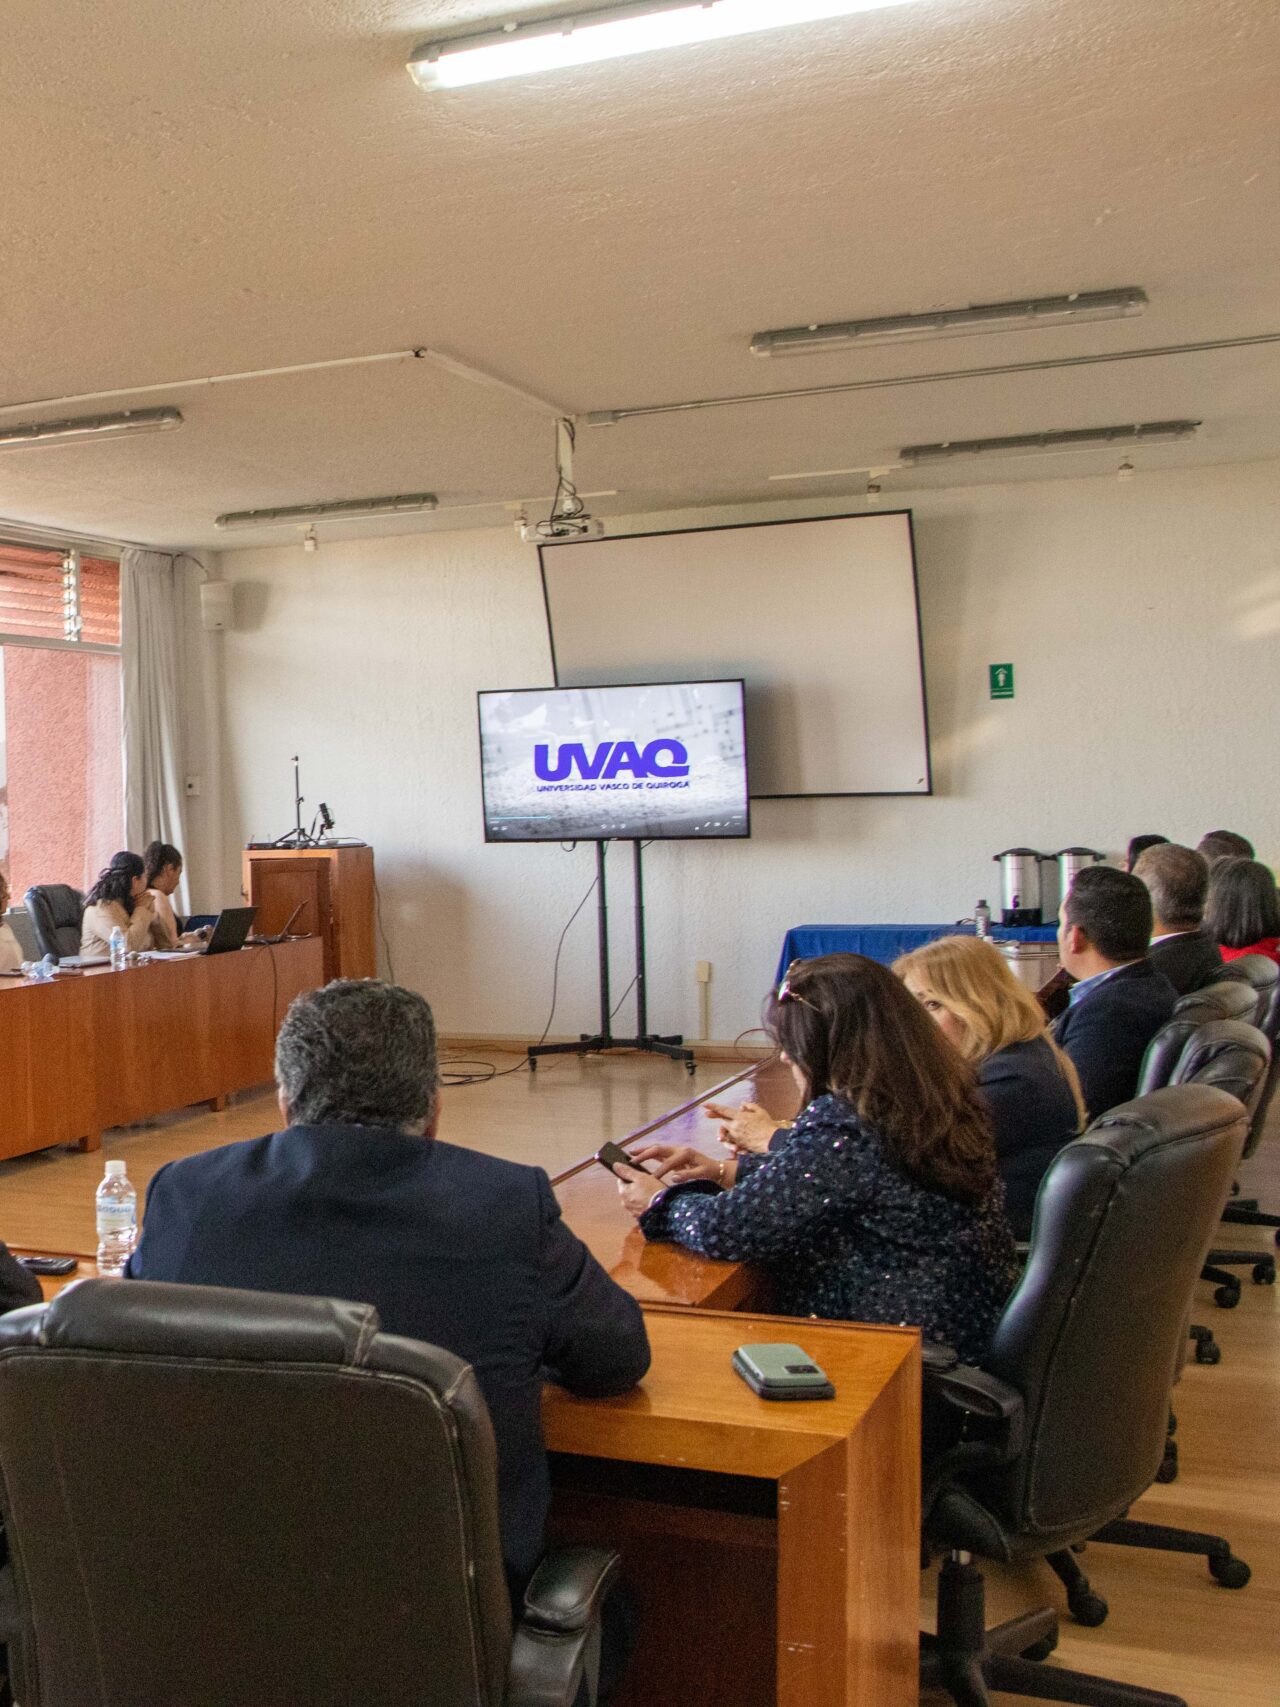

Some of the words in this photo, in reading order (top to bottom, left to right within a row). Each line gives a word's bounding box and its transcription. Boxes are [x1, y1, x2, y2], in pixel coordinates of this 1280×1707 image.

[534, 738, 689, 781] UVAQ
[536, 783, 597, 792] UNIVERSIDAD
[599, 782, 629, 791] VASCO
[632, 782, 644, 790] DE
[646, 781, 689, 789] QUIROGA
